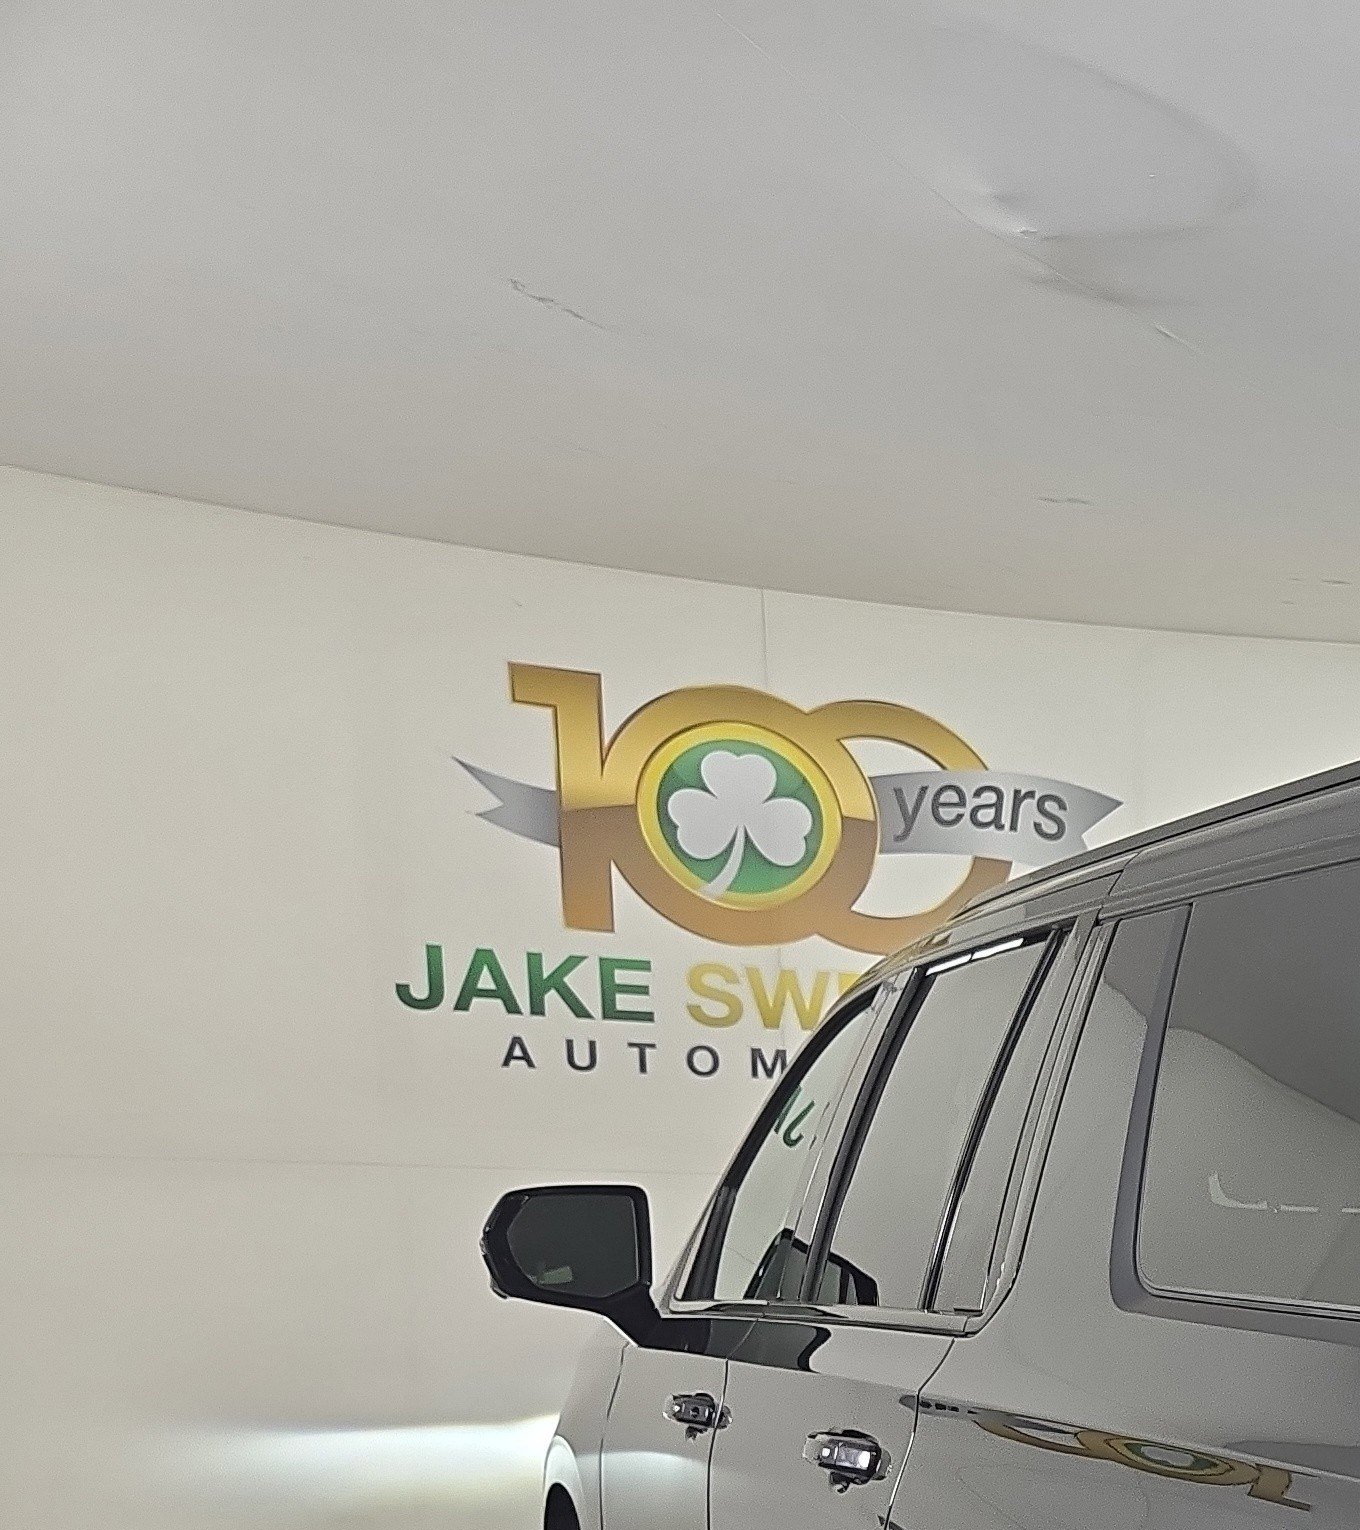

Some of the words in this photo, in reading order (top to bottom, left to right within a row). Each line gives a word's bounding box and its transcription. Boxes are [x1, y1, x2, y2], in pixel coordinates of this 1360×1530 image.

[892, 781, 1069, 842] years
[395, 943, 656, 1024] JAKE
[686, 963, 862, 1032] SW
